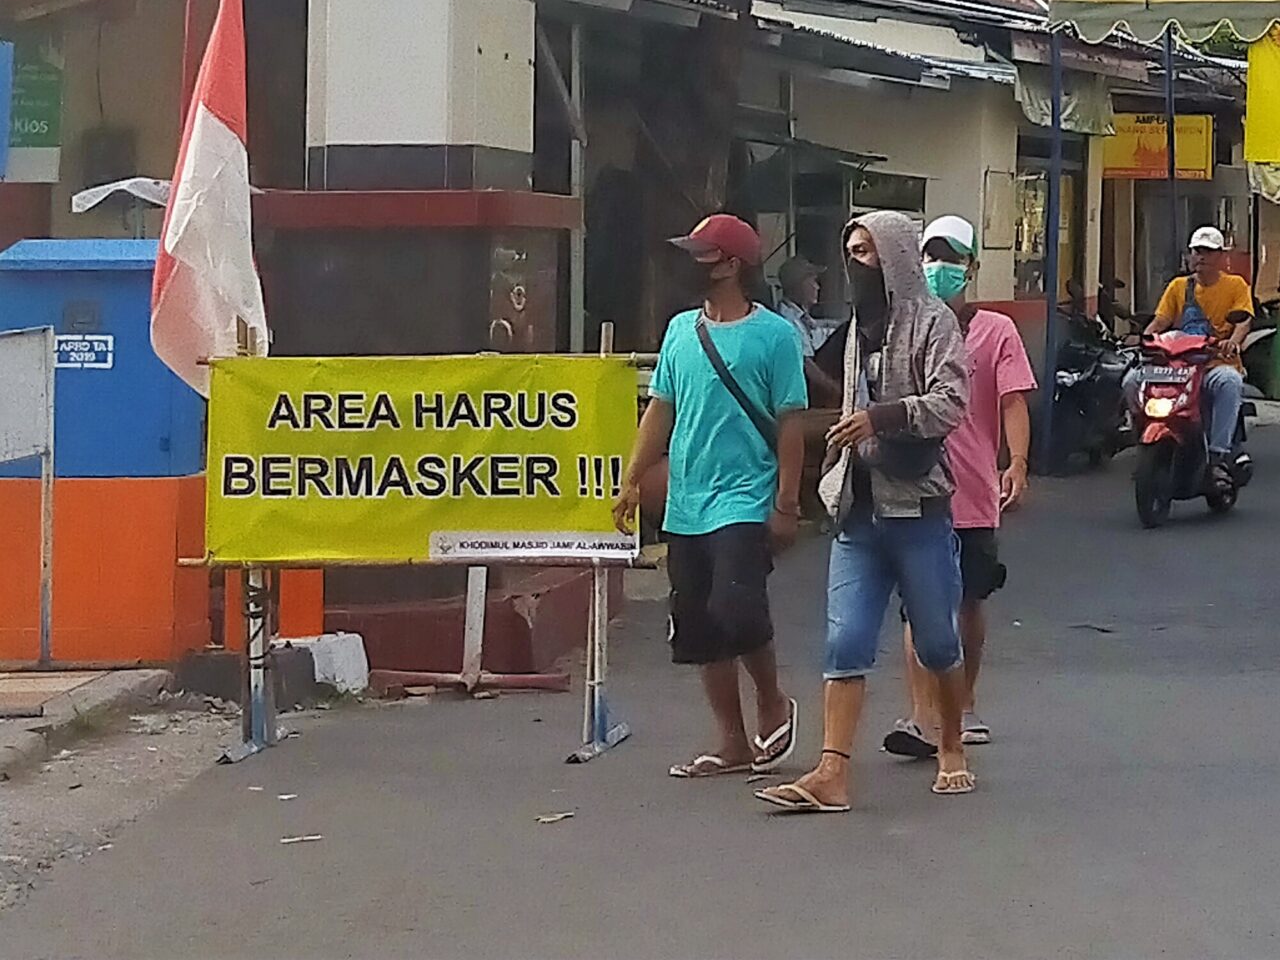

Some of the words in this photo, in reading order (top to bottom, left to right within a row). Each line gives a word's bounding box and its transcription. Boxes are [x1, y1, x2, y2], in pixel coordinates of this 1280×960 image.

[267, 392, 400, 430] AREA
[413, 392, 578, 429] HARUS
[222, 455, 560, 498] BERMASKER
[578, 455, 622, 499] !!!
[512, 541, 549, 550] MASJID
